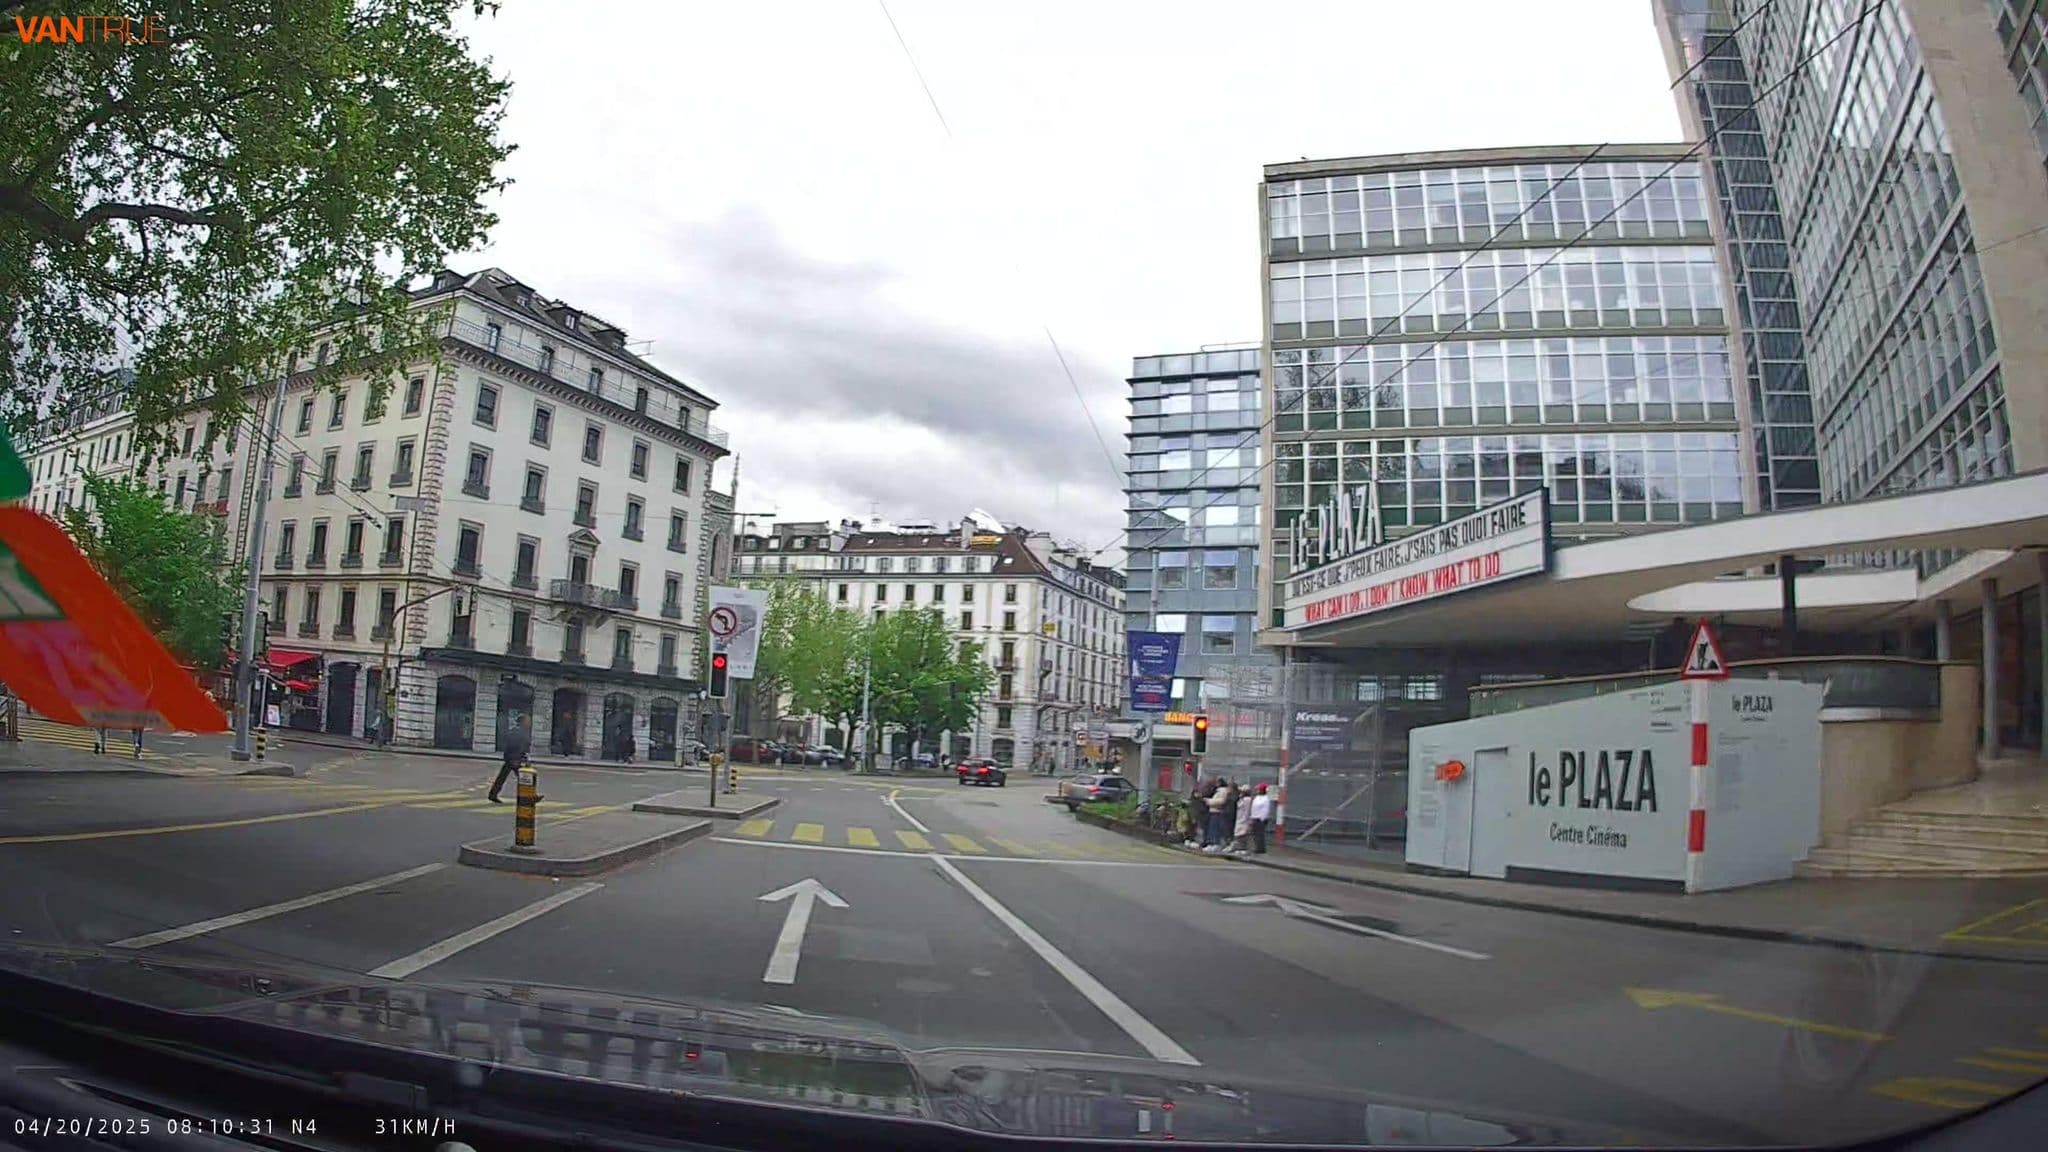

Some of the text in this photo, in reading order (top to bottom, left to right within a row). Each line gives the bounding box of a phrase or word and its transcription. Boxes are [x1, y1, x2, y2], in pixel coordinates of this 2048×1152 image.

[1290, 481, 1384, 574] LE PLAZA
[1405, 532, 1436, 562] J'SAIS
[1439, 524, 1458, 551] PAS
[1461, 514, 1487, 544] QUOI
[1490, 501, 1526, 539] FAIRE
[1401, 571, 1428, 600] KNOW
[1433, 561, 1463, 590] WHAT
[1468, 555, 1481, 582] TO
[1485, 551, 1500, 578] DO
[1743, 695, 1773, 713] PLAZA
[1528, 750, 1551, 807] le
[1558, 748, 1658, 813] PLAZA
[1549, 821, 1629, 849] Centre Cinéma
